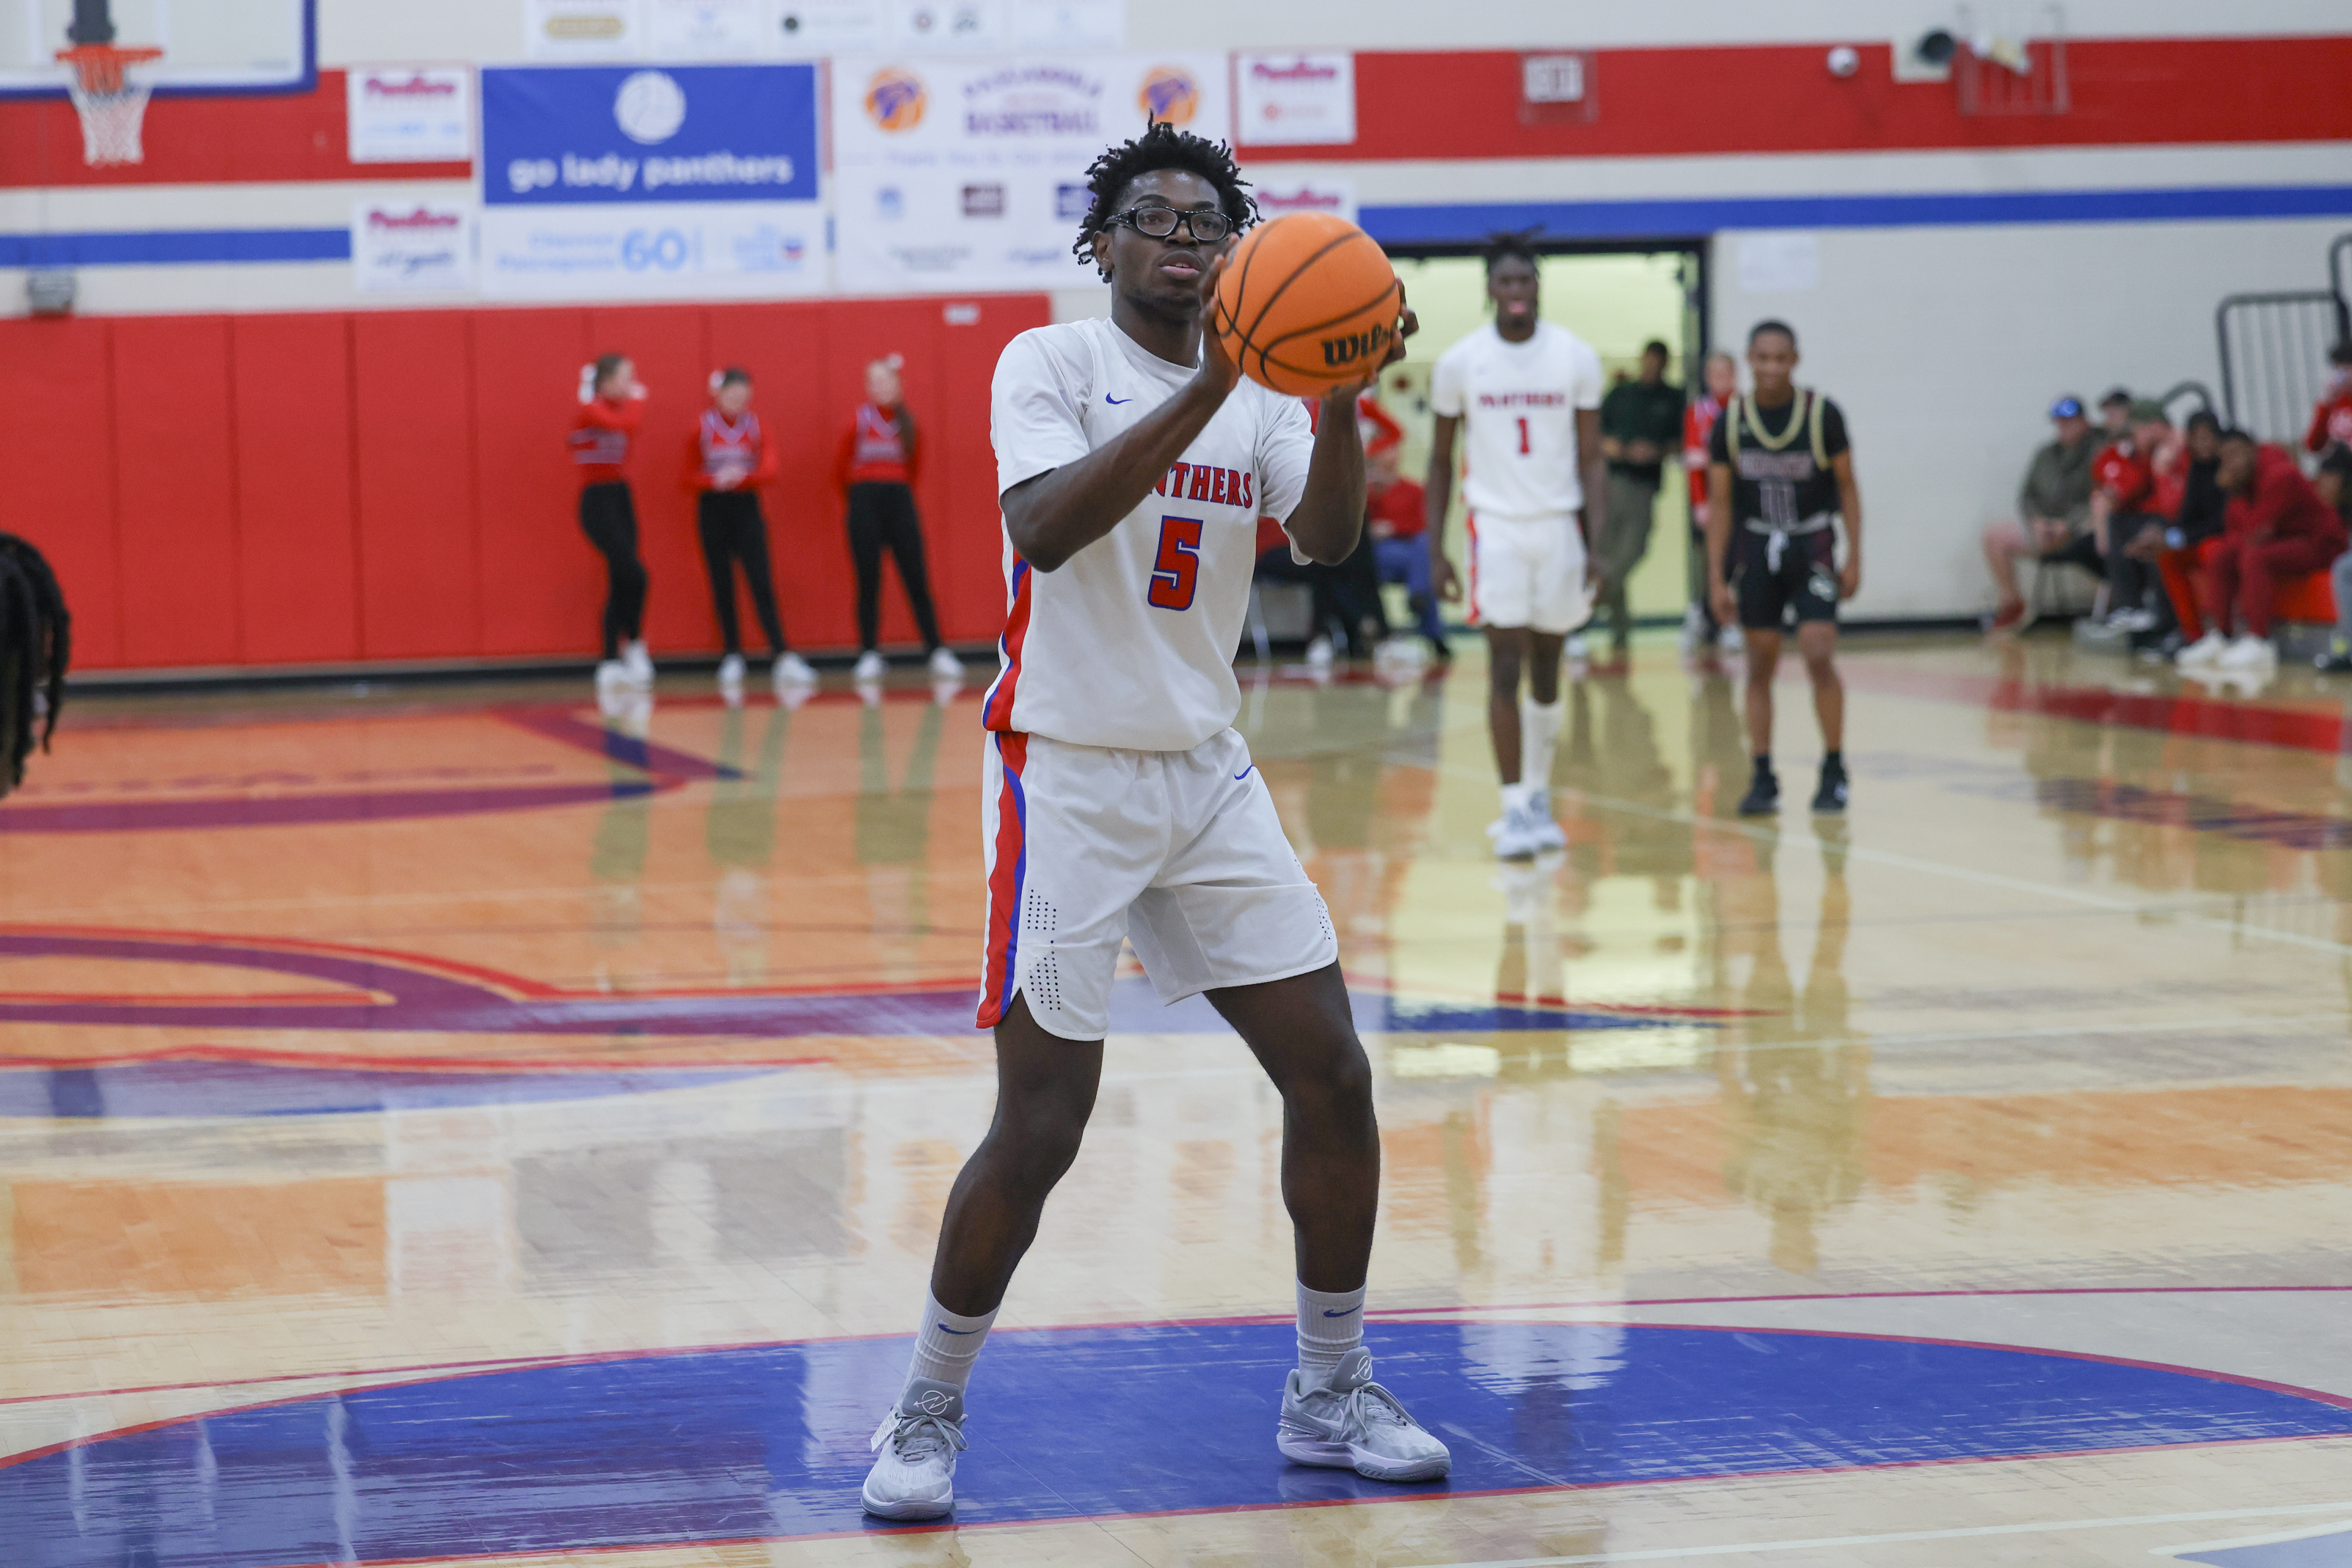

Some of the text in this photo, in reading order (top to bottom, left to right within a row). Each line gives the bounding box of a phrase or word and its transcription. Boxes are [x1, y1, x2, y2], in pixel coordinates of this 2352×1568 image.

[508, 149, 795, 193] go lady panthers
[622, 228, 687, 274] 60
[1516, 417, 1530, 454] 1
[1147, 515, 1203, 611] 5
